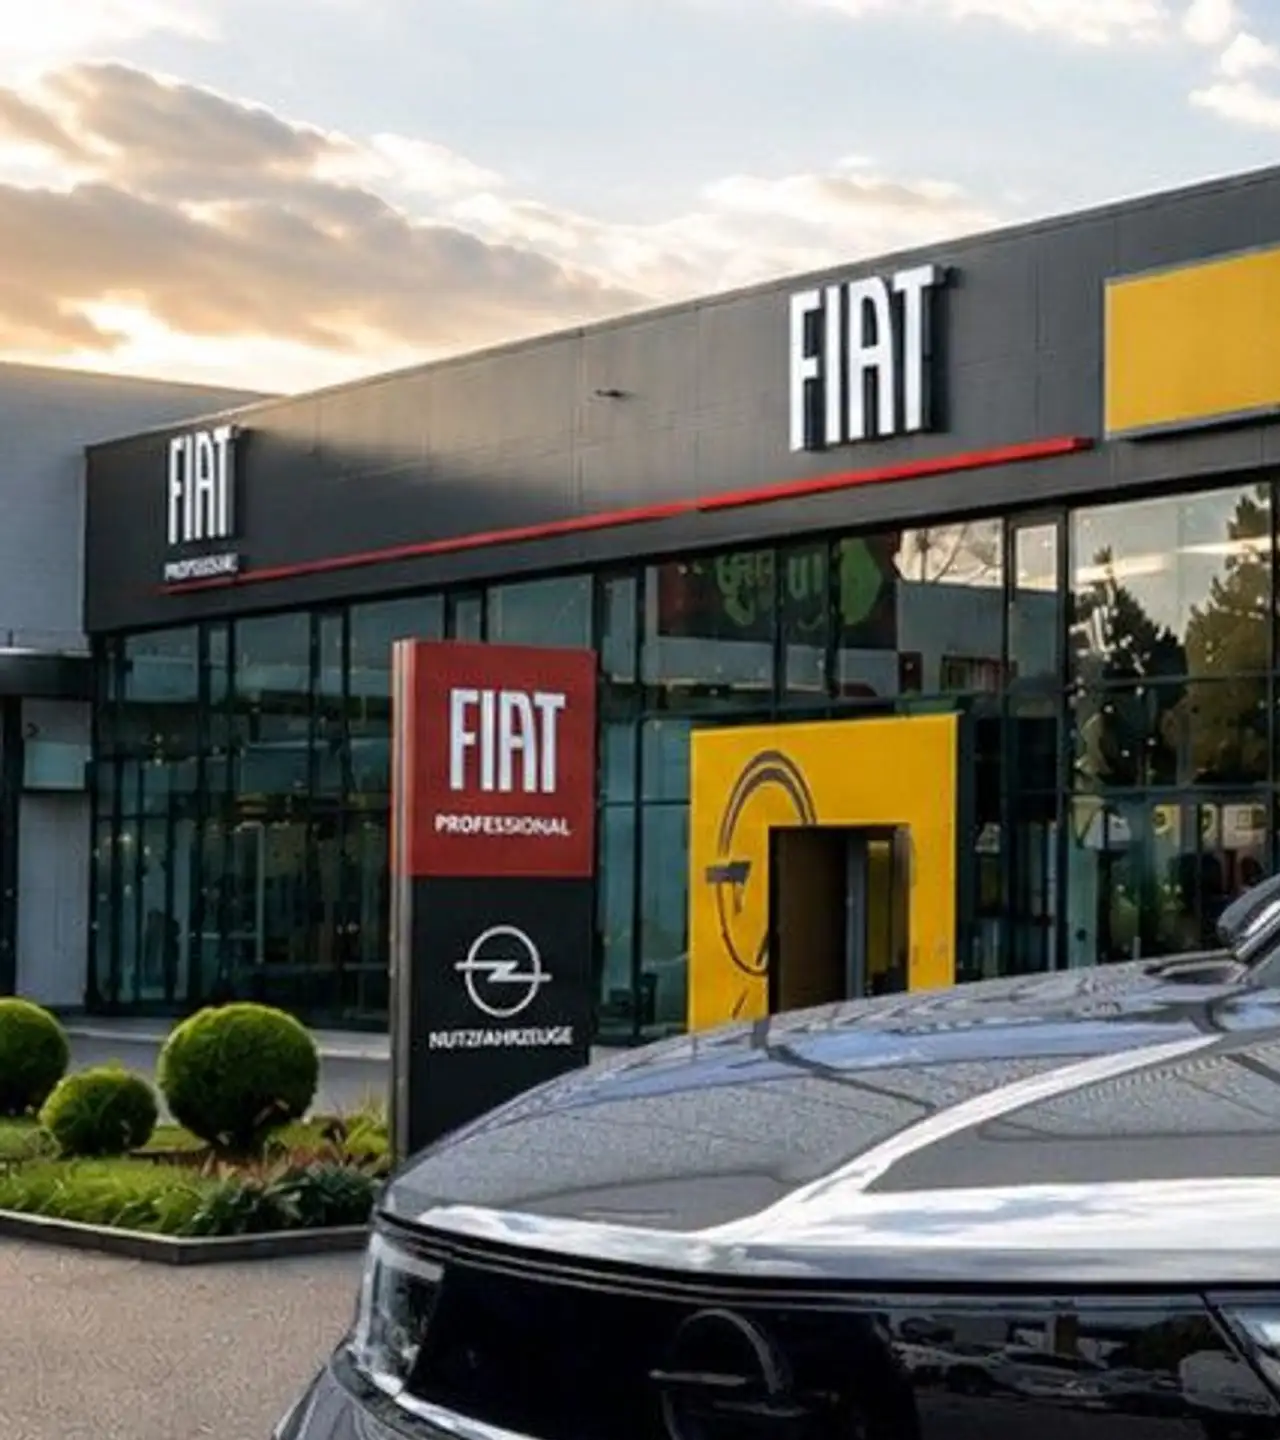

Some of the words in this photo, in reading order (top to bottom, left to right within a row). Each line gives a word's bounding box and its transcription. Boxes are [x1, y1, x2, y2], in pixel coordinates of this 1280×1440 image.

[789, 264, 936, 452] FIAT
[168, 426, 231, 544] FIAT
[449, 688, 565, 793] FIAT
[434, 814, 572, 836] PROFESSIONAL
